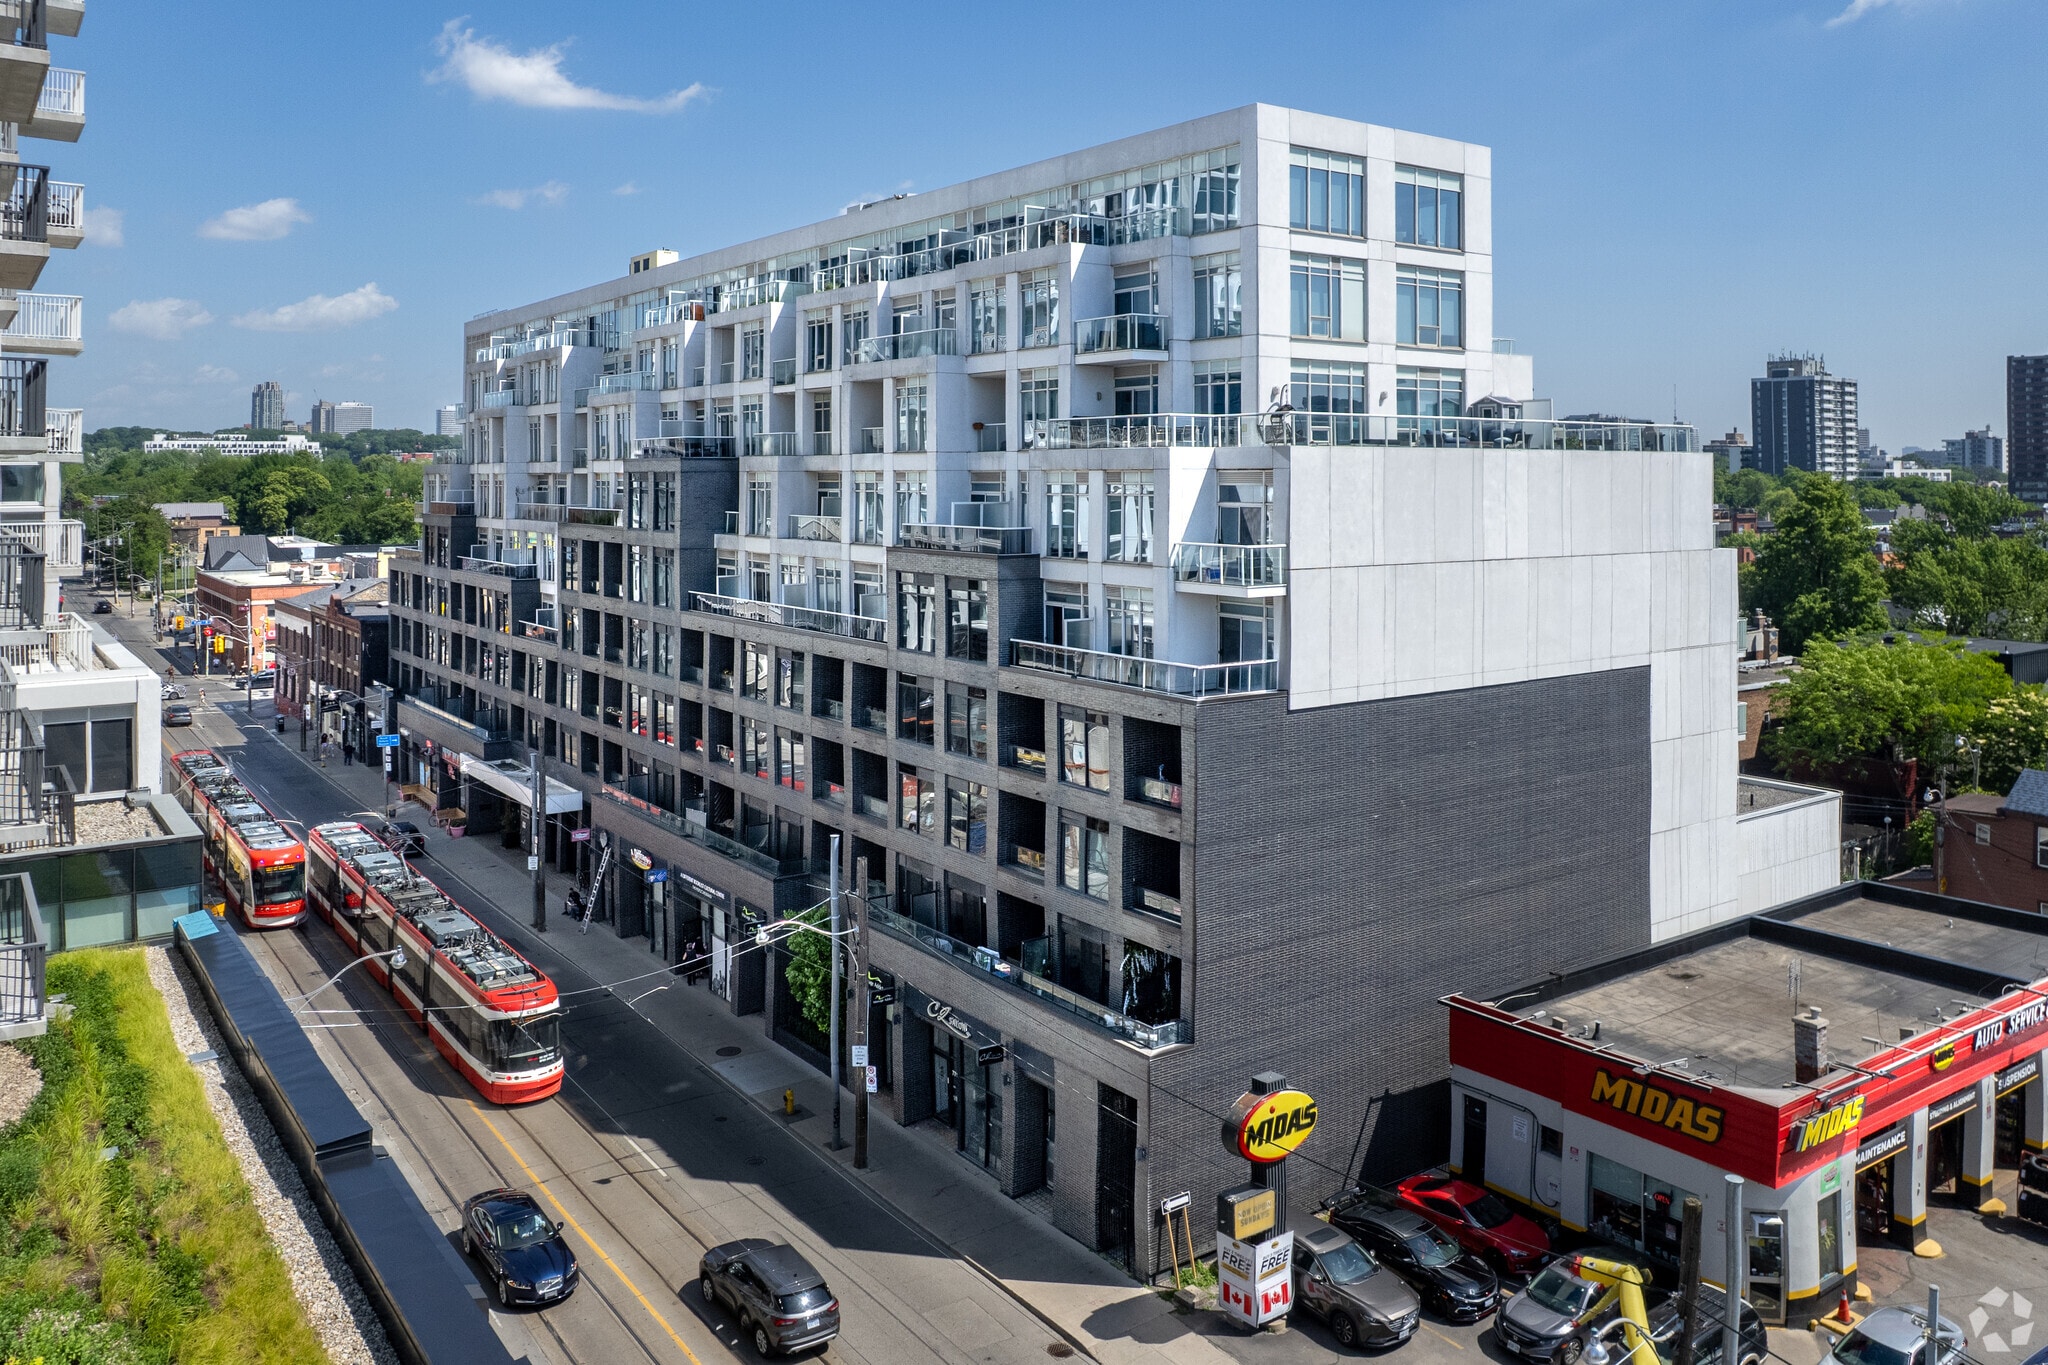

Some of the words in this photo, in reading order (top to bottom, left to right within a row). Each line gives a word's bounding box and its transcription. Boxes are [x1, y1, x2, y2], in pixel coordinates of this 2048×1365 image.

[1975, 1021, 2003, 1051] AUTO
[2008, 1003, 2046, 1035] SERVICE
[1998, 1062, 2036, 1090] SUSPENSION
[1591, 1070, 1721, 1142] MIDAS
[1246, 1102, 1318, 1149] MIDAS
[1801, 1096, 1865, 1152] MIDAS
[1856, 1130, 1906, 1165] MAINTENANCE
[1238, 1208, 1251, 1219] NOW
[1253, 1200, 1272, 1212] OPEN
[1654, 1193, 1671, 1205] OPEN
[1240, 1210, 1270, 1227] SUNDAYS
[1222, 1250, 1252, 1275] FREE
[1260, 1248, 1290, 1273] FREE
